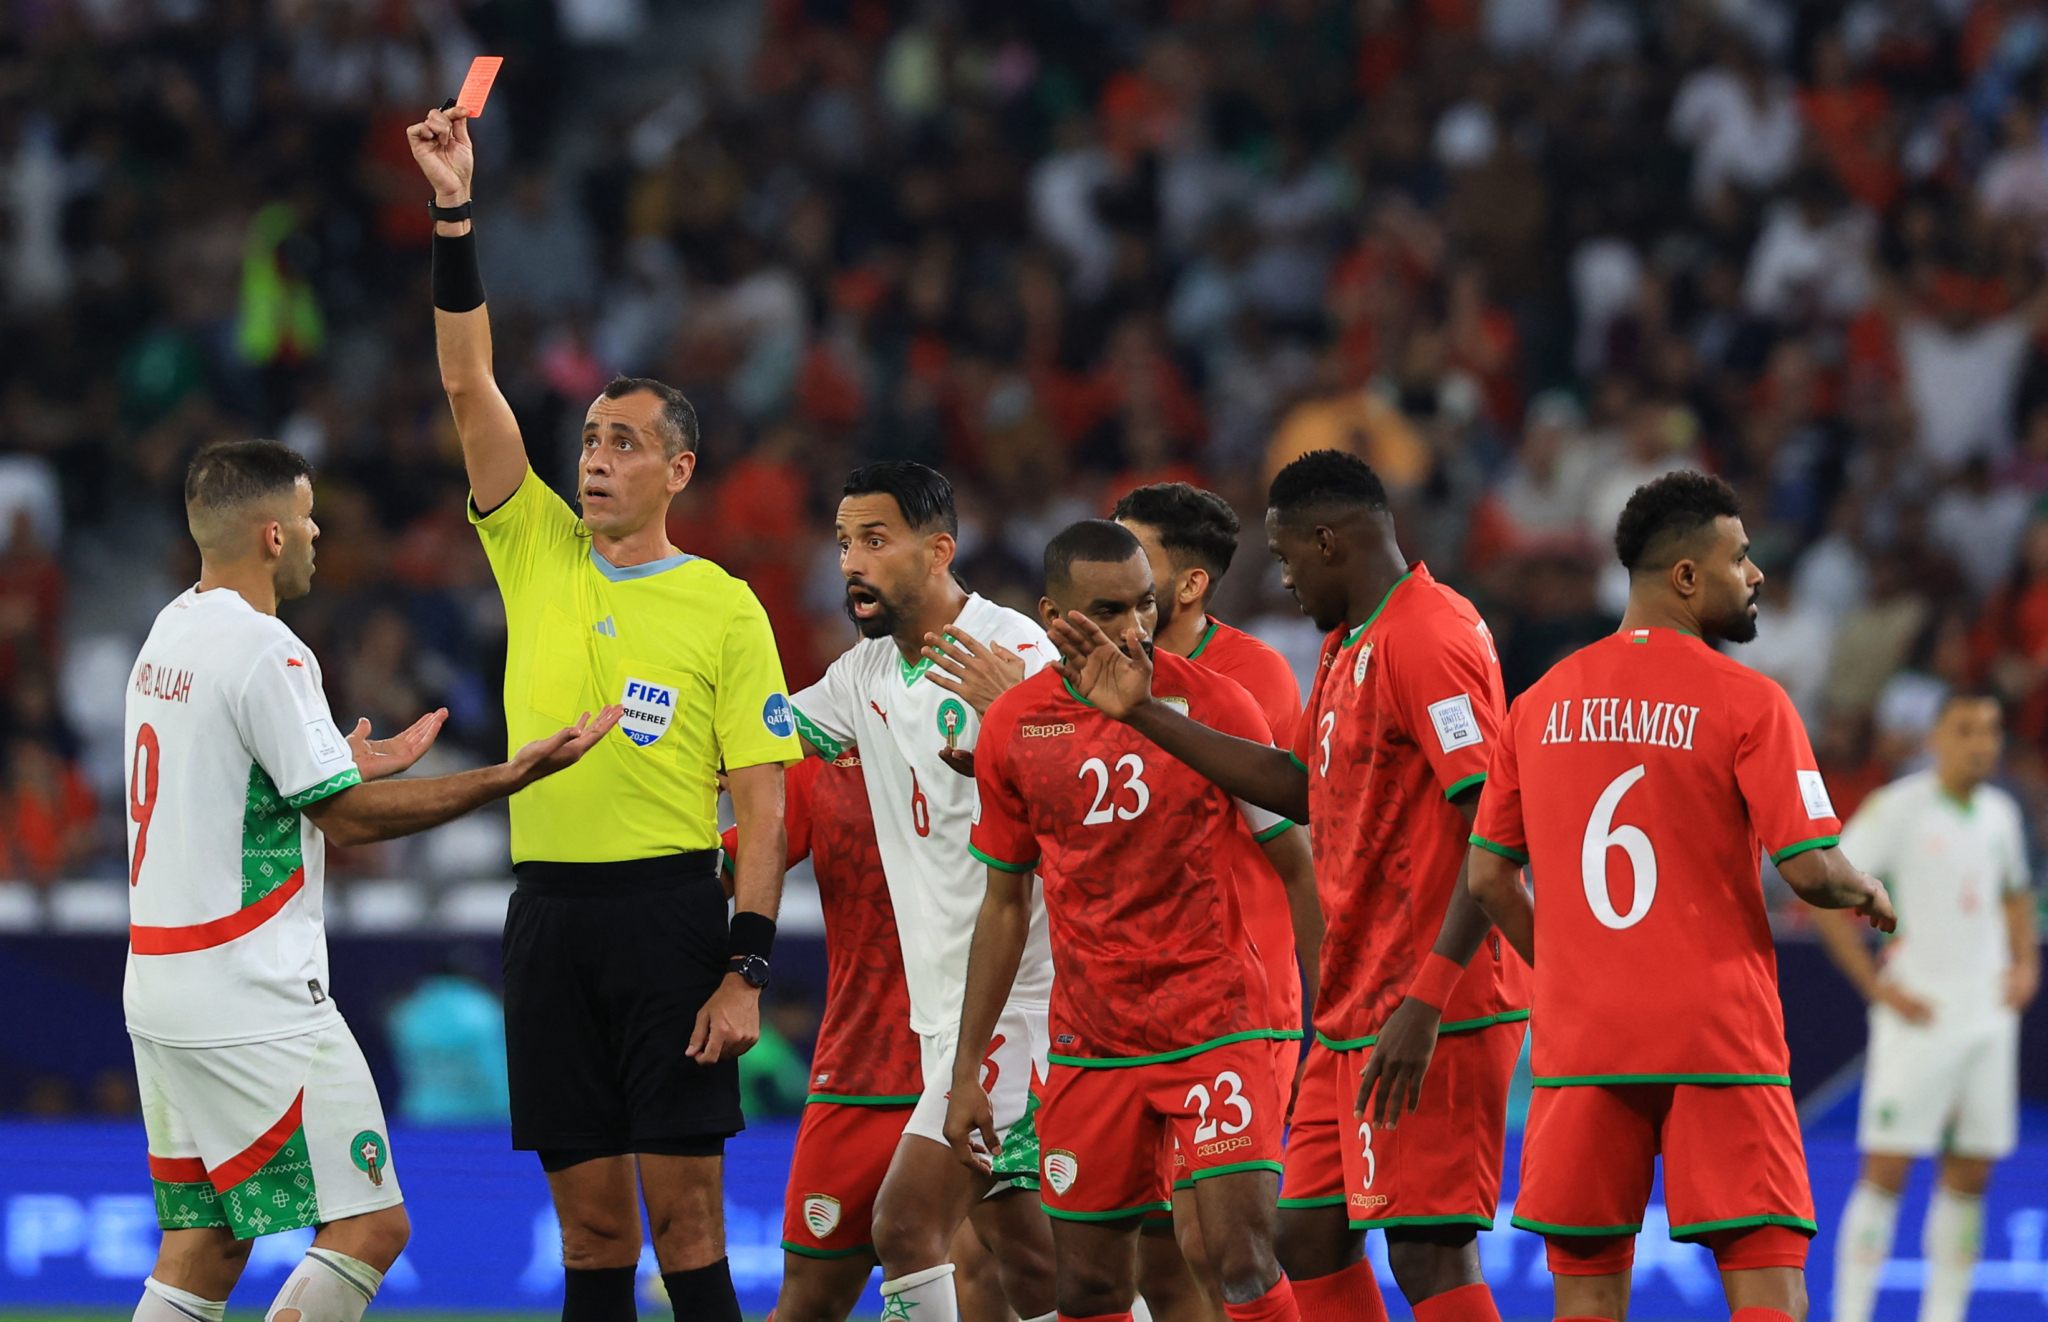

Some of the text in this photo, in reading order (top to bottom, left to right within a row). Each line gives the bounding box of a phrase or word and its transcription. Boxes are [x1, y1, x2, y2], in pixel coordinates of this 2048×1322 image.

[153, 666, 194, 704] ALLAH
[627, 682, 670, 707] FIFA
[623, 708, 667, 726] REFEREE
[630, 731, 650, 743] 2025
[1022, 723, 1076, 738] Kappa
[1541, 698, 1700, 750] AL KHAMISI
[1320, 711, 1335, 778] 3
[131, 722, 160, 887] 9
[910, 765, 930, 838] 6
[1078, 753, 1150, 826] 23
[1581, 763, 1658, 930] 6
[1183, 1070, 1253, 1144] 23
[1197, 1135, 1252, 1157] Kappa
[1358, 1121, 1376, 1190] 3
[1350, 1193, 1388, 1208] Kappa
